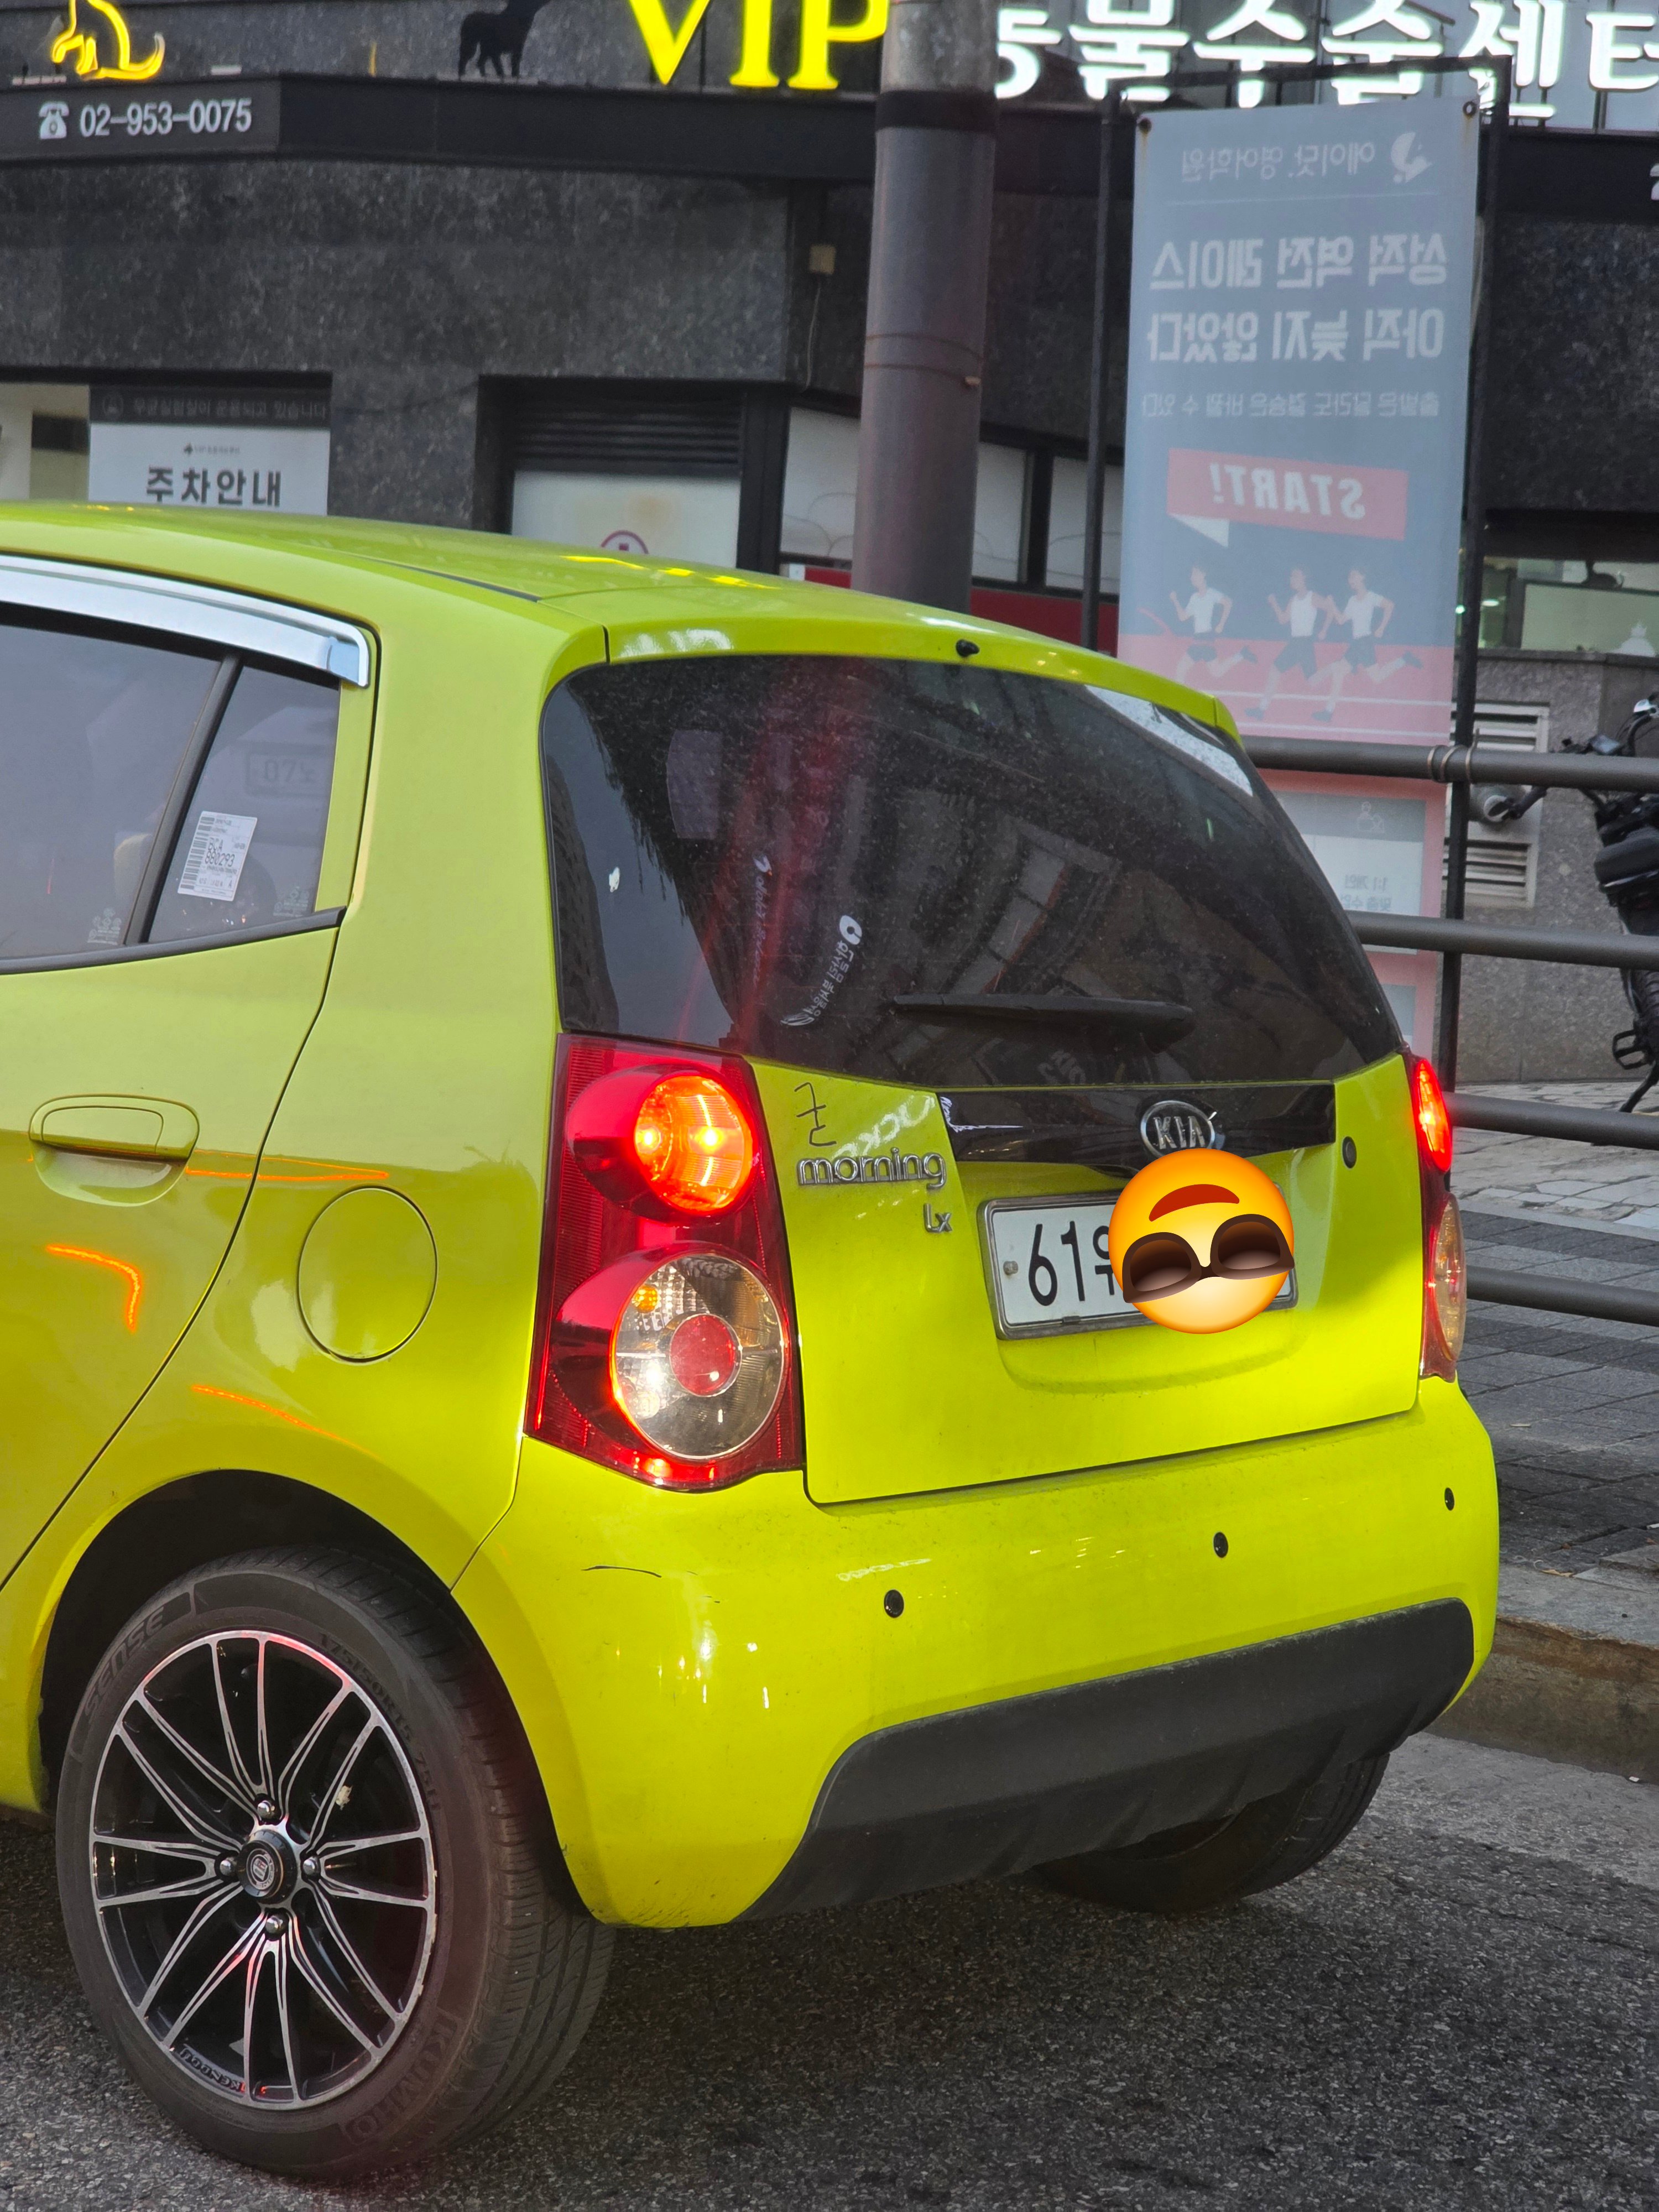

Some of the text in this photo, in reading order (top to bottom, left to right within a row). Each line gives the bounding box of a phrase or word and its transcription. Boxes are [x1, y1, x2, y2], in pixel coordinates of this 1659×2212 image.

[629, 0, 888, 90] VIP
[80, 98, 252, 137] 02-953-0075
[146, 465, 282, 507] 주차안내
[1152, 1115, 1207, 1150] KIA
[797, 1147, 947, 1190] morning
[354, 2021, 454, 2140] KUMHO
